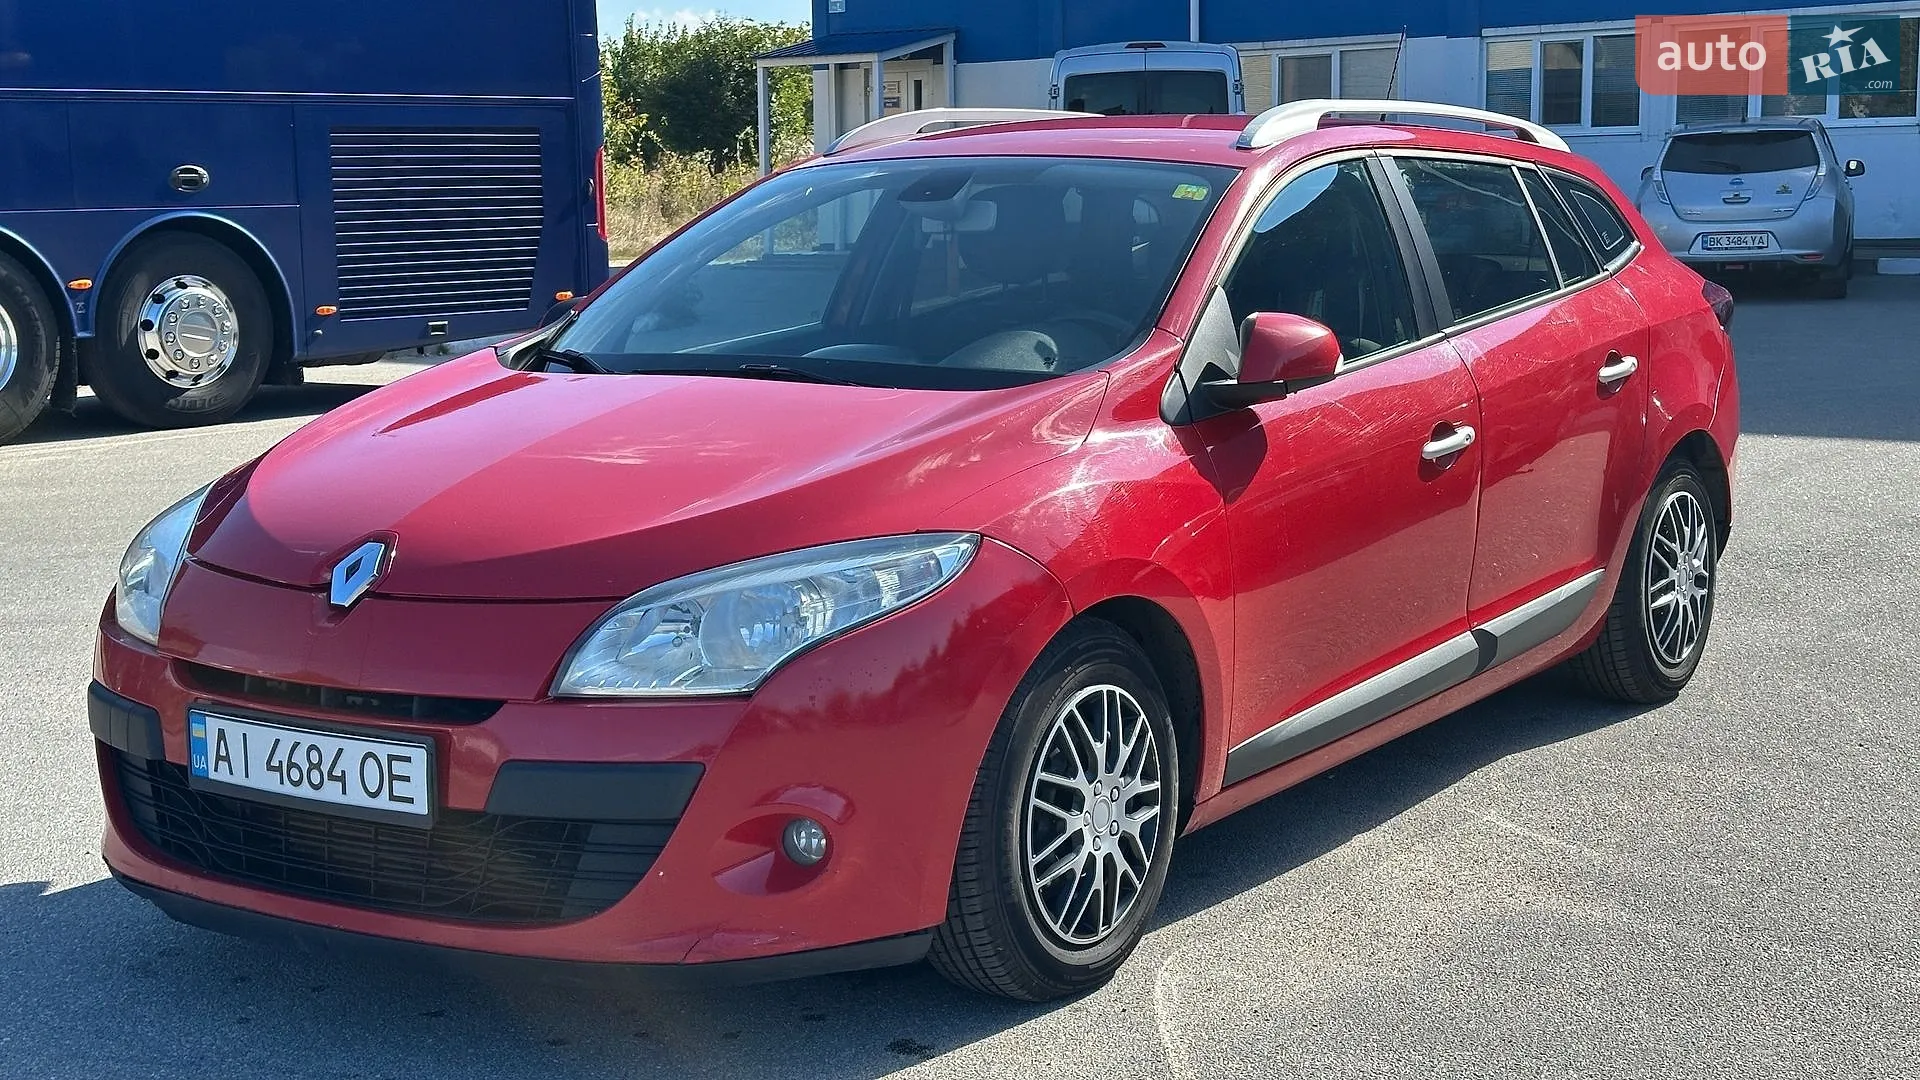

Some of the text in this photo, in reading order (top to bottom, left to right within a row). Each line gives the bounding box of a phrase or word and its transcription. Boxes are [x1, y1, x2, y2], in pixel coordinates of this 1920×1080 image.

[1708, 235, 1765, 247] BK 3484 YA
[193, 754, 207, 770] UA
[213, 727, 415, 805] AI 4684 OE
